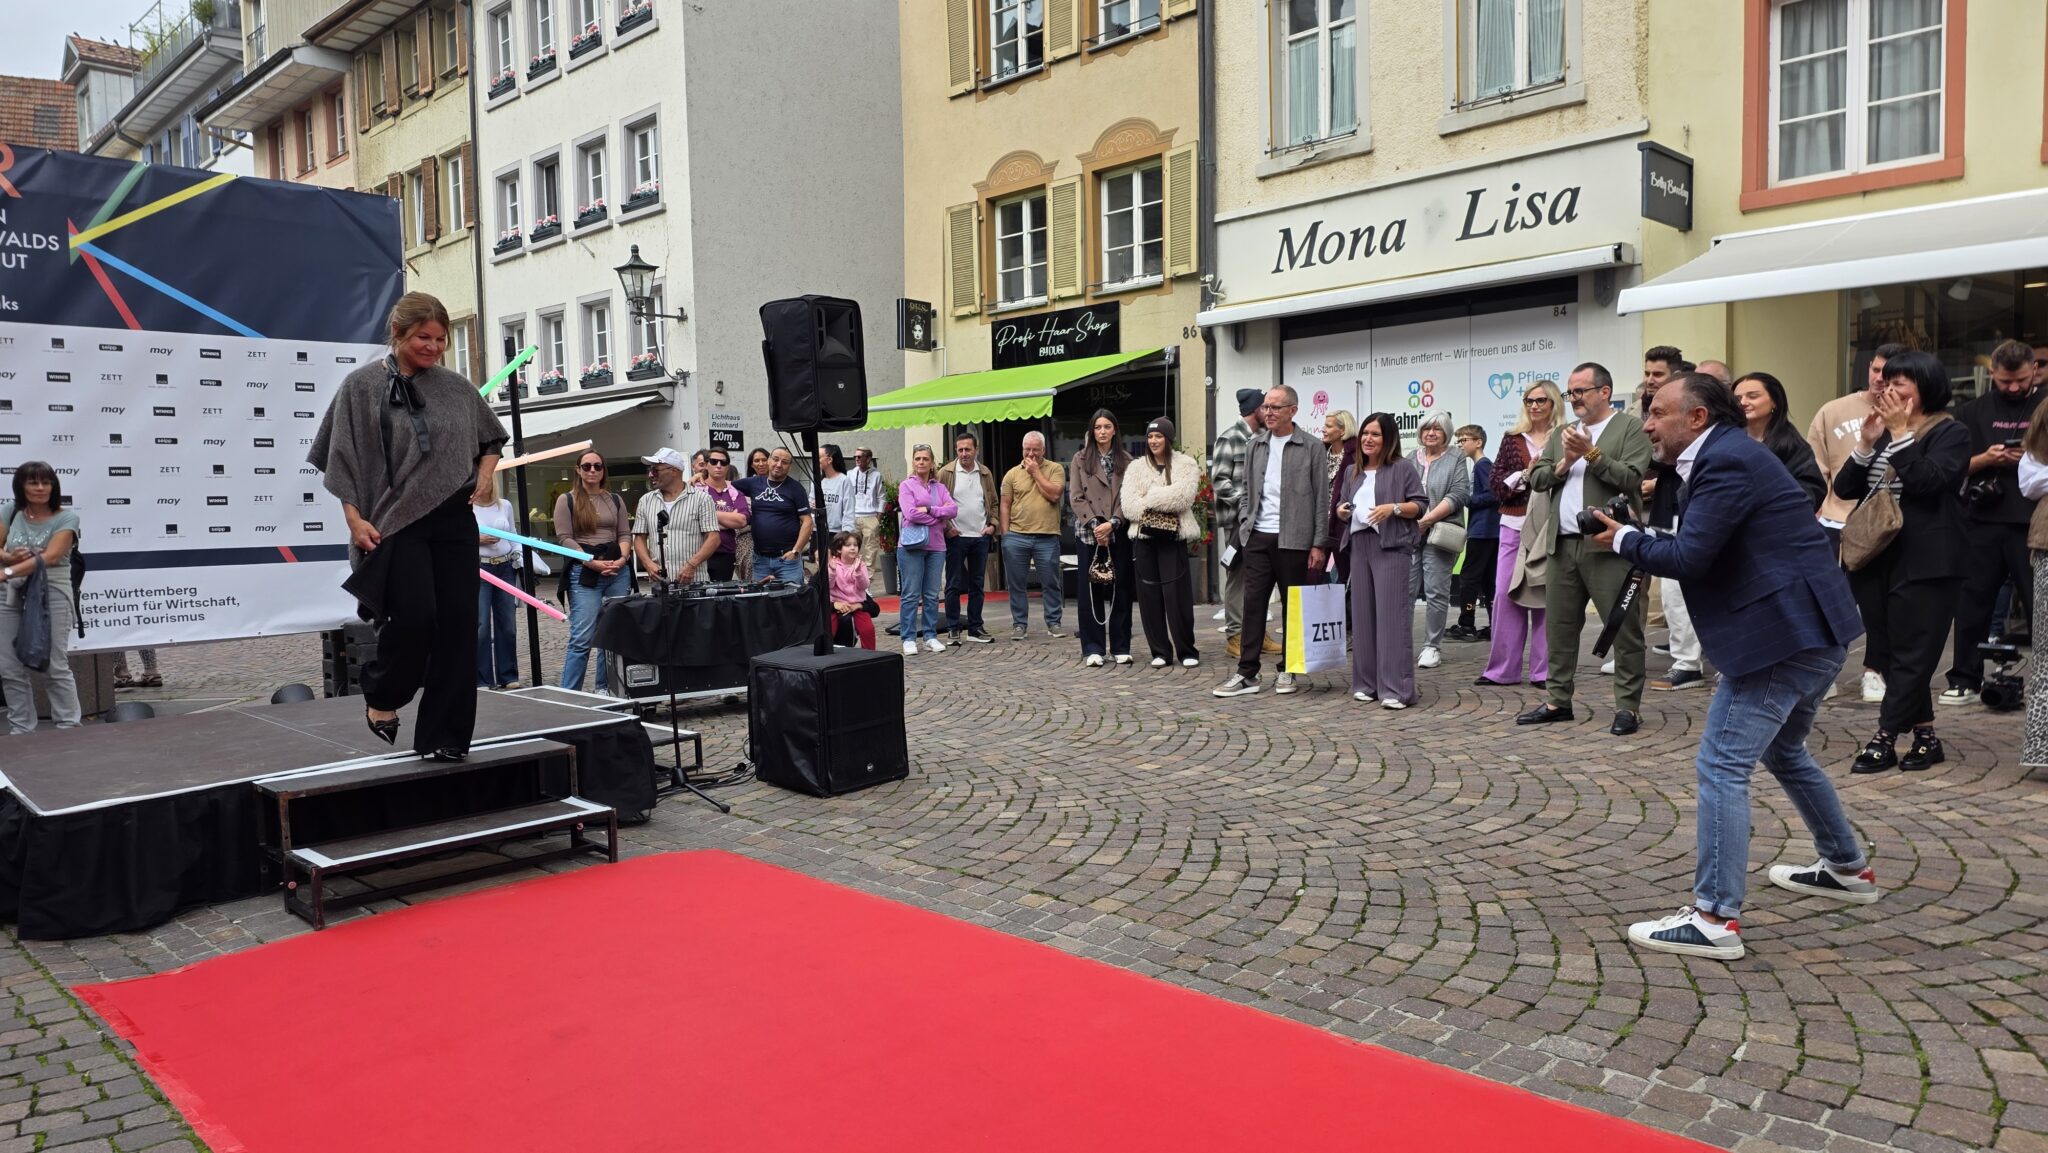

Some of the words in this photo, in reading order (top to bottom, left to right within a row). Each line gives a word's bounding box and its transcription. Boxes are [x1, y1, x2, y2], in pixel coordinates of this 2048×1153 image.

[1271, 218, 1407, 274] Mona
[1455, 182, 1581, 241] Lisa
[1553, 305, 1567, 317] 84
[995, 325, 1035, 354] Profi
[1037, 317, 1075, 345] Haar
[1076, 311, 1111, 342] Shop
[1182, 325, 1197, 339] 86
[150, 347, 173, 356] may
[1302, 366, 1315, 376] Alle
[1317, 363, 1354, 375] Standorte
[1355, 361, 1369, 370] nur
[1374, 358, 1378, 368] 1
[1381, 356, 1408, 367] Minute
[1411, 352, 1443, 364] entfernt
[1453, 348, 1469, 359] Wir
[1471, 346, 1499, 357] freuen
[1501, 344, 1518, 354] uns
[1521, 340, 1536, 352] auf
[1538, 339, 1556, 350] Sie.
[0, 371, 16, 380] ay
[246, 381, 269, 390] may
[101, 406, 125, 415] may
[711, 421, 739, 429] Reinhard
[52, 434, 75, 442] ZETT
[712, 431, 733, 442] 20m
[1833, 427, 1845, 440] A
[203, 438, 226, 447] may
[55, 468, 80, 477] may
[299, 467, 320, 476] may
[157, 498, 181, 507] may
[255, 525, 277, 533] may
[81, 586, 198, 601] en-Württemberg
[1621, 582, 1638, 611] SONY
[81, 602, 139, 615] isterium
[143, 600, 163, 611] für
[165, 596, 241, 609] Wirtschaft,
[104, 616, 131, 628] und
[134, 612, 206, 625] Tourismus
[1311, 621, 1343, 643] ZETT
